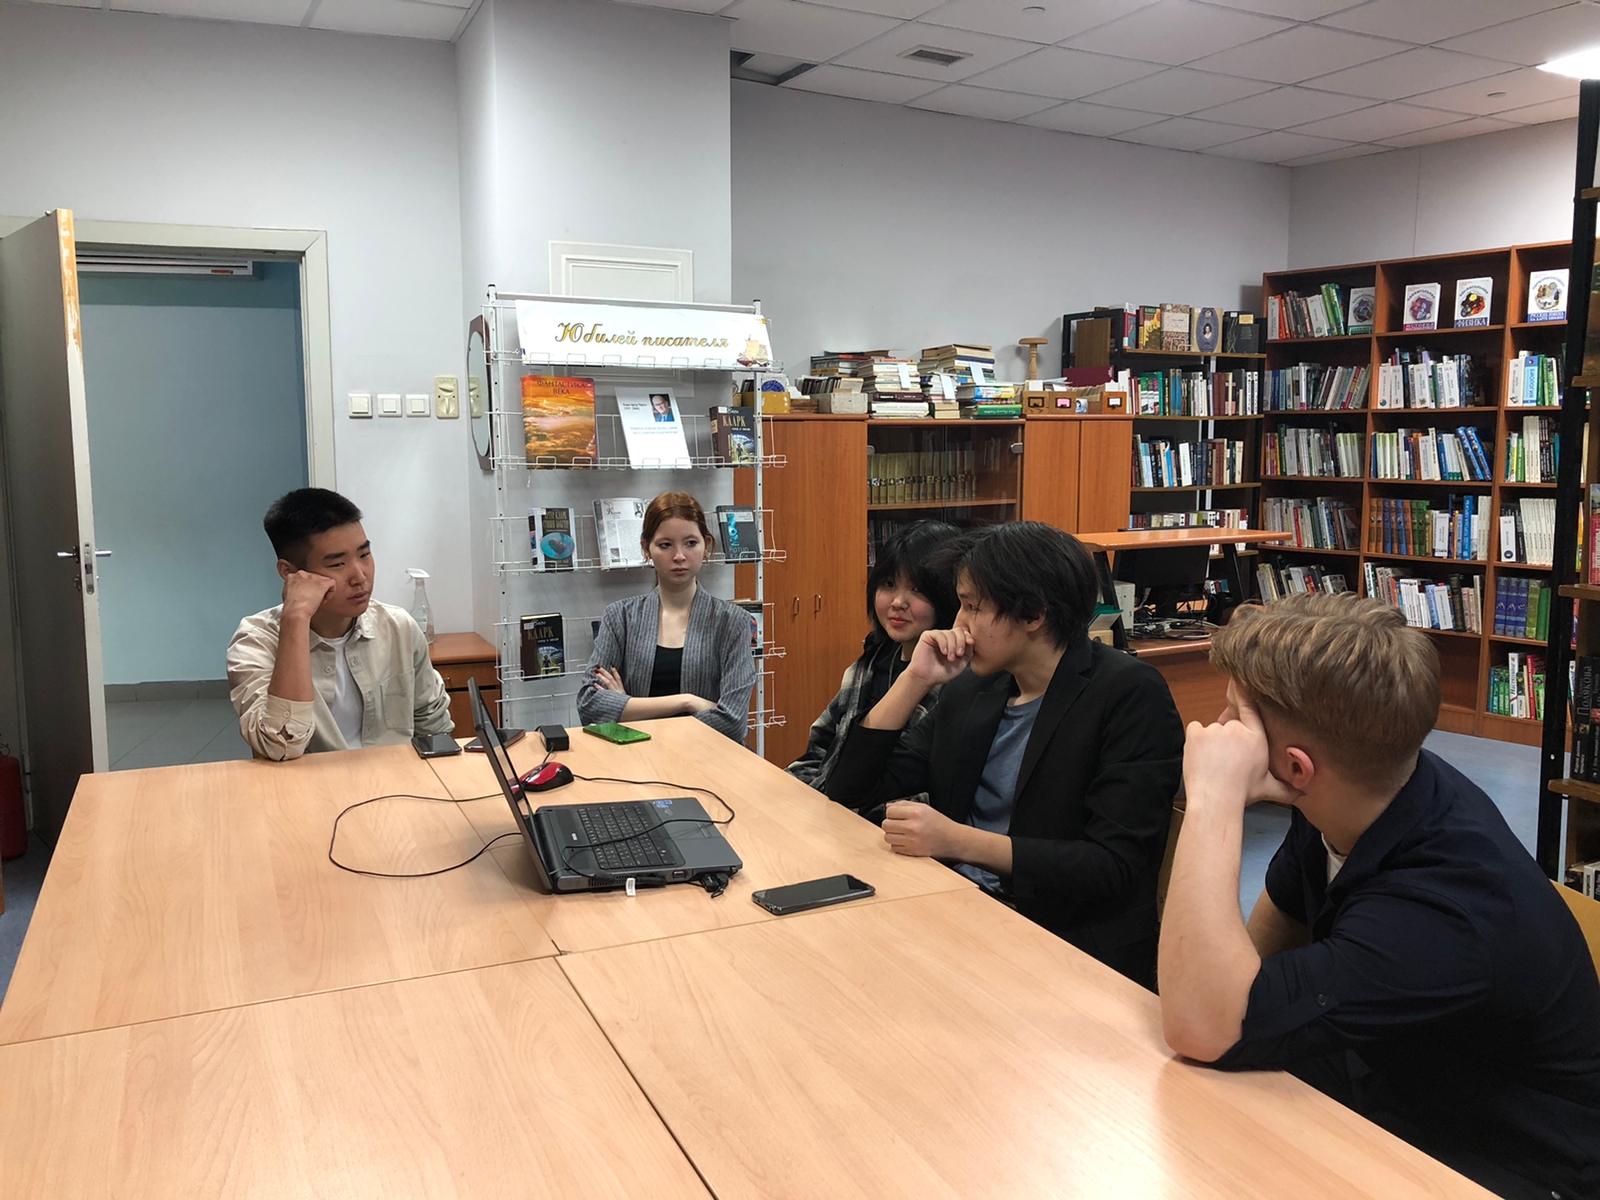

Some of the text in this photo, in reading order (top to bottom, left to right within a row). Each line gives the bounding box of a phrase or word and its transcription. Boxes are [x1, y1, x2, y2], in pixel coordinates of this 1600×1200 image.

[1456, 318, 1486, 327] ФИЗИКА
[555, 322, 729, 348] Юбилей писателя
[537, 380, 586, 389] ФАНТАСТИКА
[1577, 666, 1592, 716] Полякова
